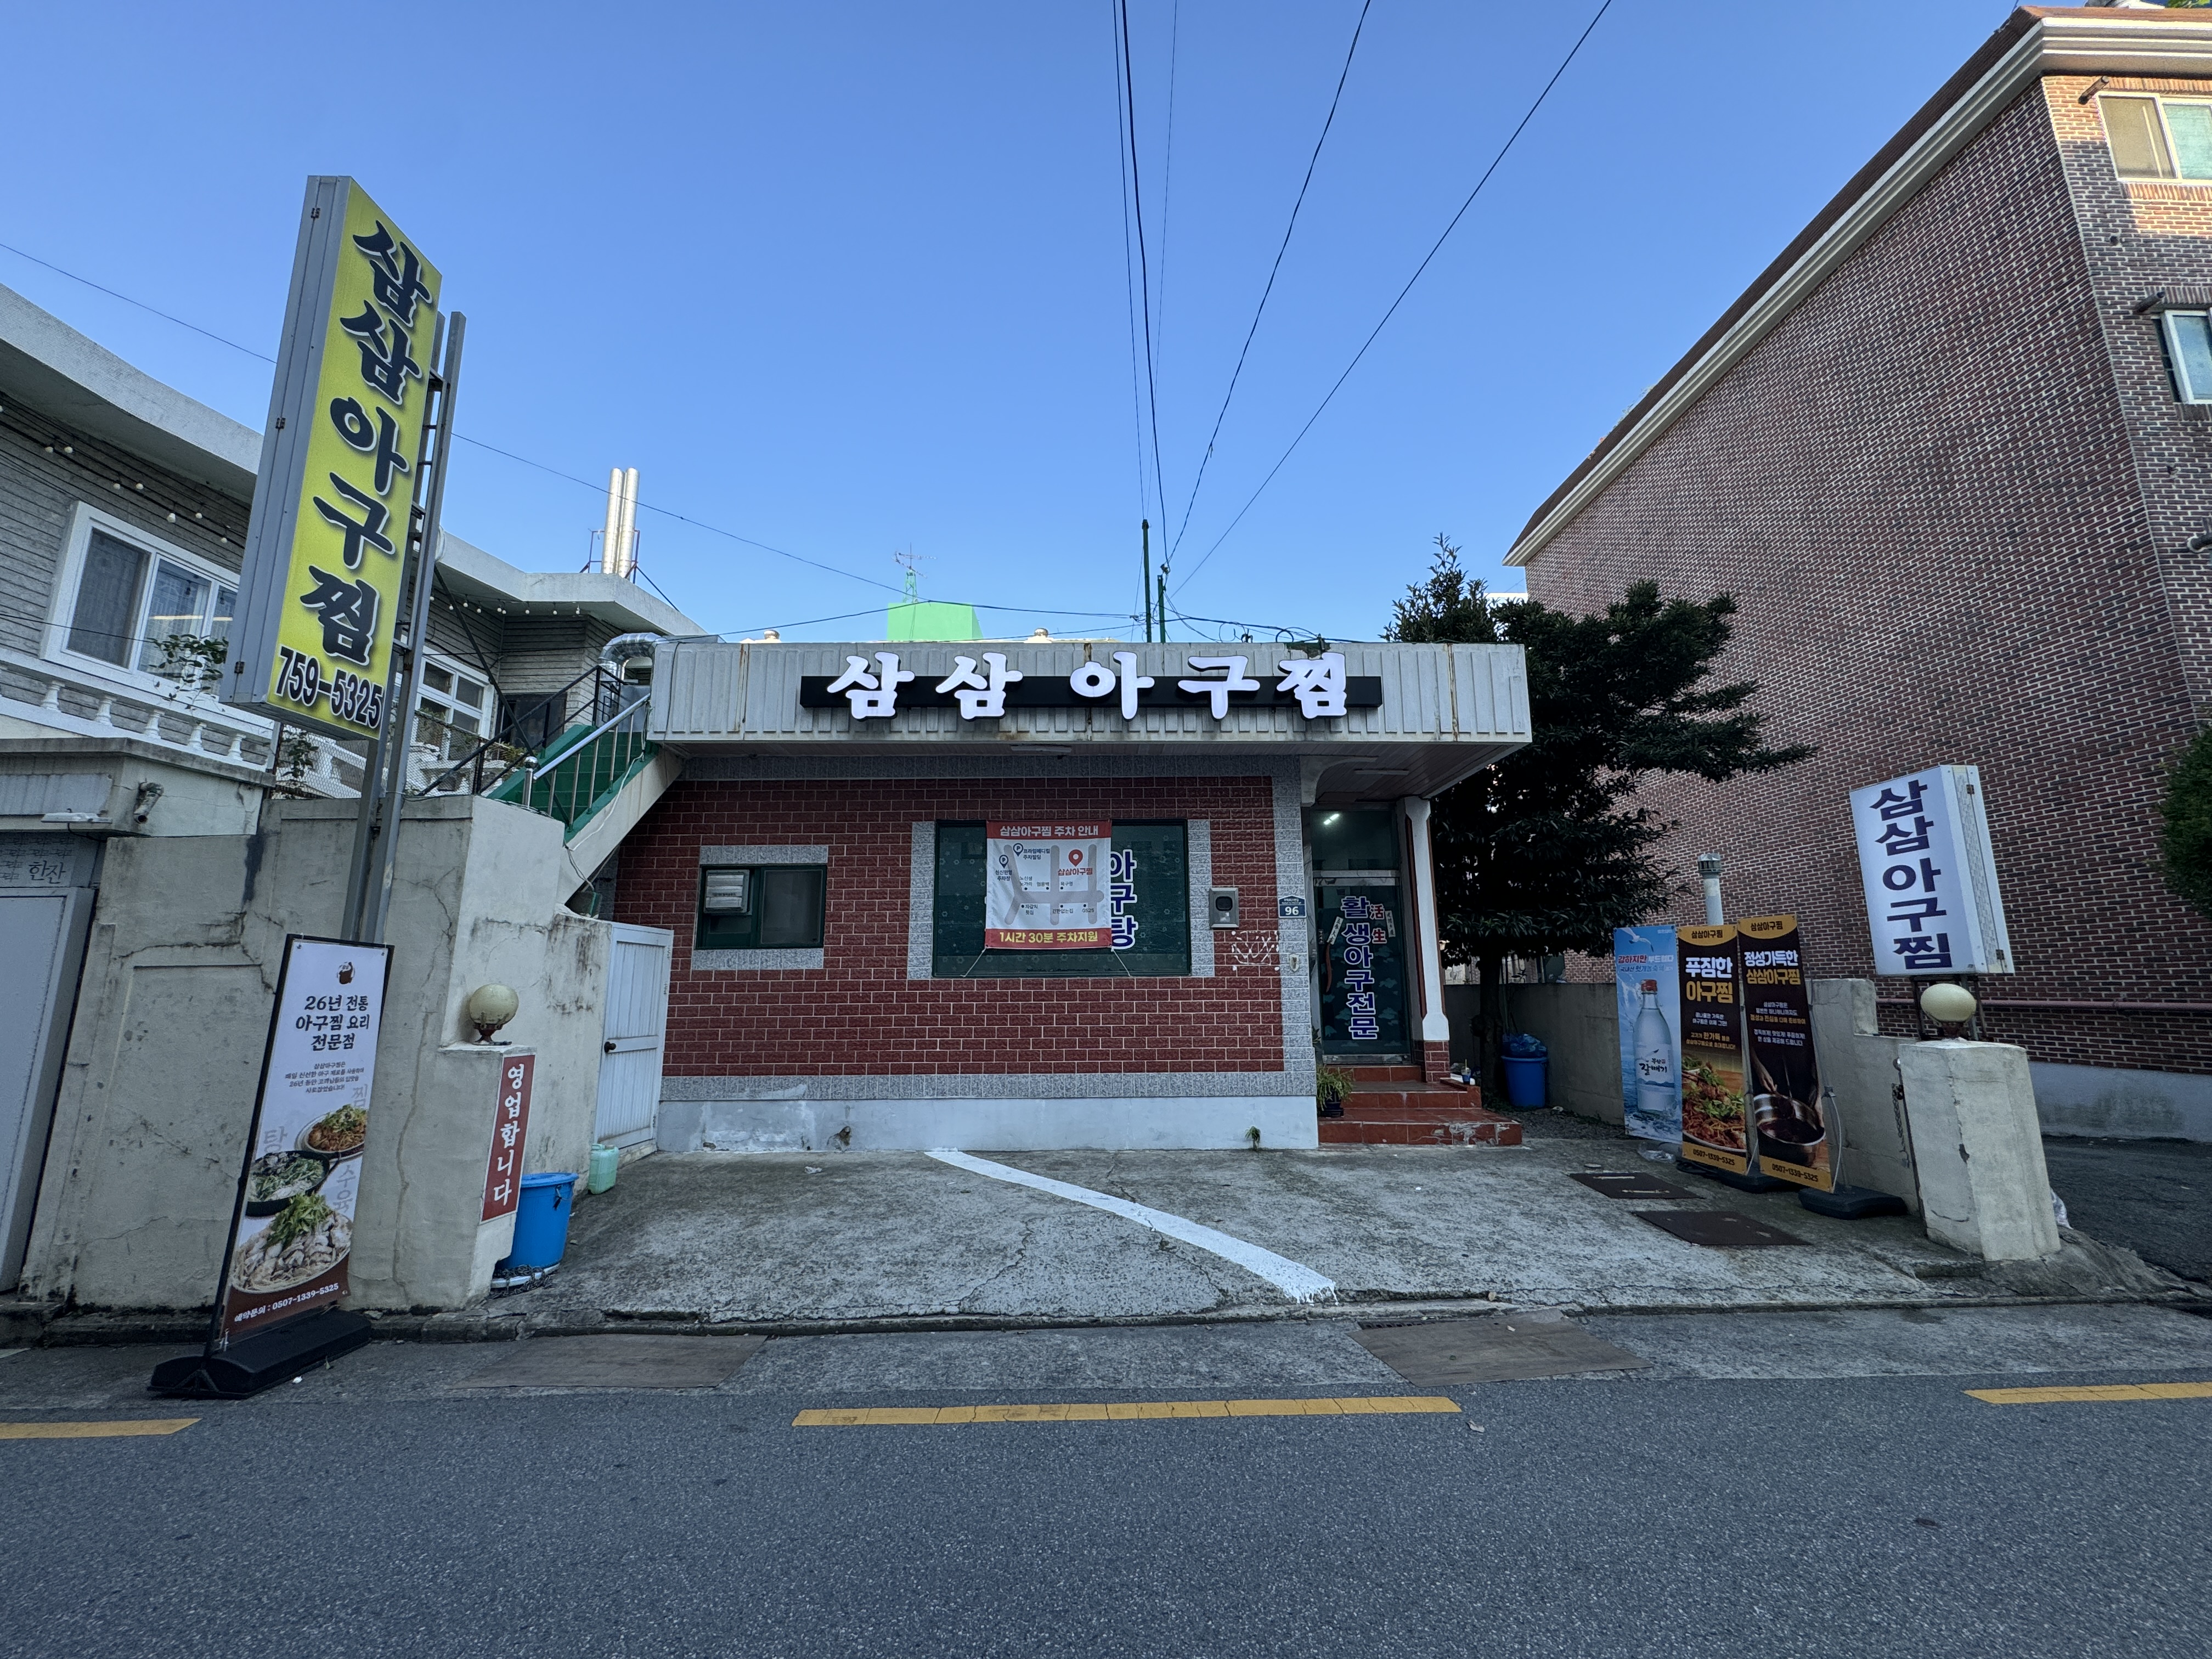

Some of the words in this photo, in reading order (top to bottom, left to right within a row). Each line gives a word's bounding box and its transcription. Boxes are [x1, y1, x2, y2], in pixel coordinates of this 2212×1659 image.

[274, 644, 383, 729] 759-5325
[1000, 826, 1052, 837] 삼삼아구찜
[1054, 826, 1075, 837] 주차
[1078, 826, 1098, 836] 안내
[29, 860, 66, 884] 한잔
[1870, 779, 1952, 969] 삼삼아구찜
[1285, 906, 1299, 915] 96
[1750, 921, 1783, 931] 삼삼아구찜
[1000, 932, 1025, 943] 1시간
[1029, 932, 1053, 943] 30분
[1057, 932, 1098, 943] 주차지원
[1691, 930, 1723, 939] 삼삼아구찜
[1618, 955, 1647, 963] 강하지만
[1744, 951, 1798, 966] 정성가득한
[1685, 957, 1733, 978] 푸짐한
[1746, 969, 1801, 984] 삼삼아구찜
[1686, 982, 1733, 1003] 아구찜
[304, 995, 342, 1011] 26년
[346, 995, 368, 1011] 전통
[296, 1015, 343, 1031] 아구찜
[347, 1015, 370, 1029] 요리
[311, 1034, 355, 1051] 전문점
[494, 1063, 524, 1206] 영업합니다
[1693, 1148, 1735, 1166] 0507-1339-5325
[1772, 1164, 1818, 1182] 0507-1339-5325
[273, 1283, 339, 1310] 0507-1339-5325
